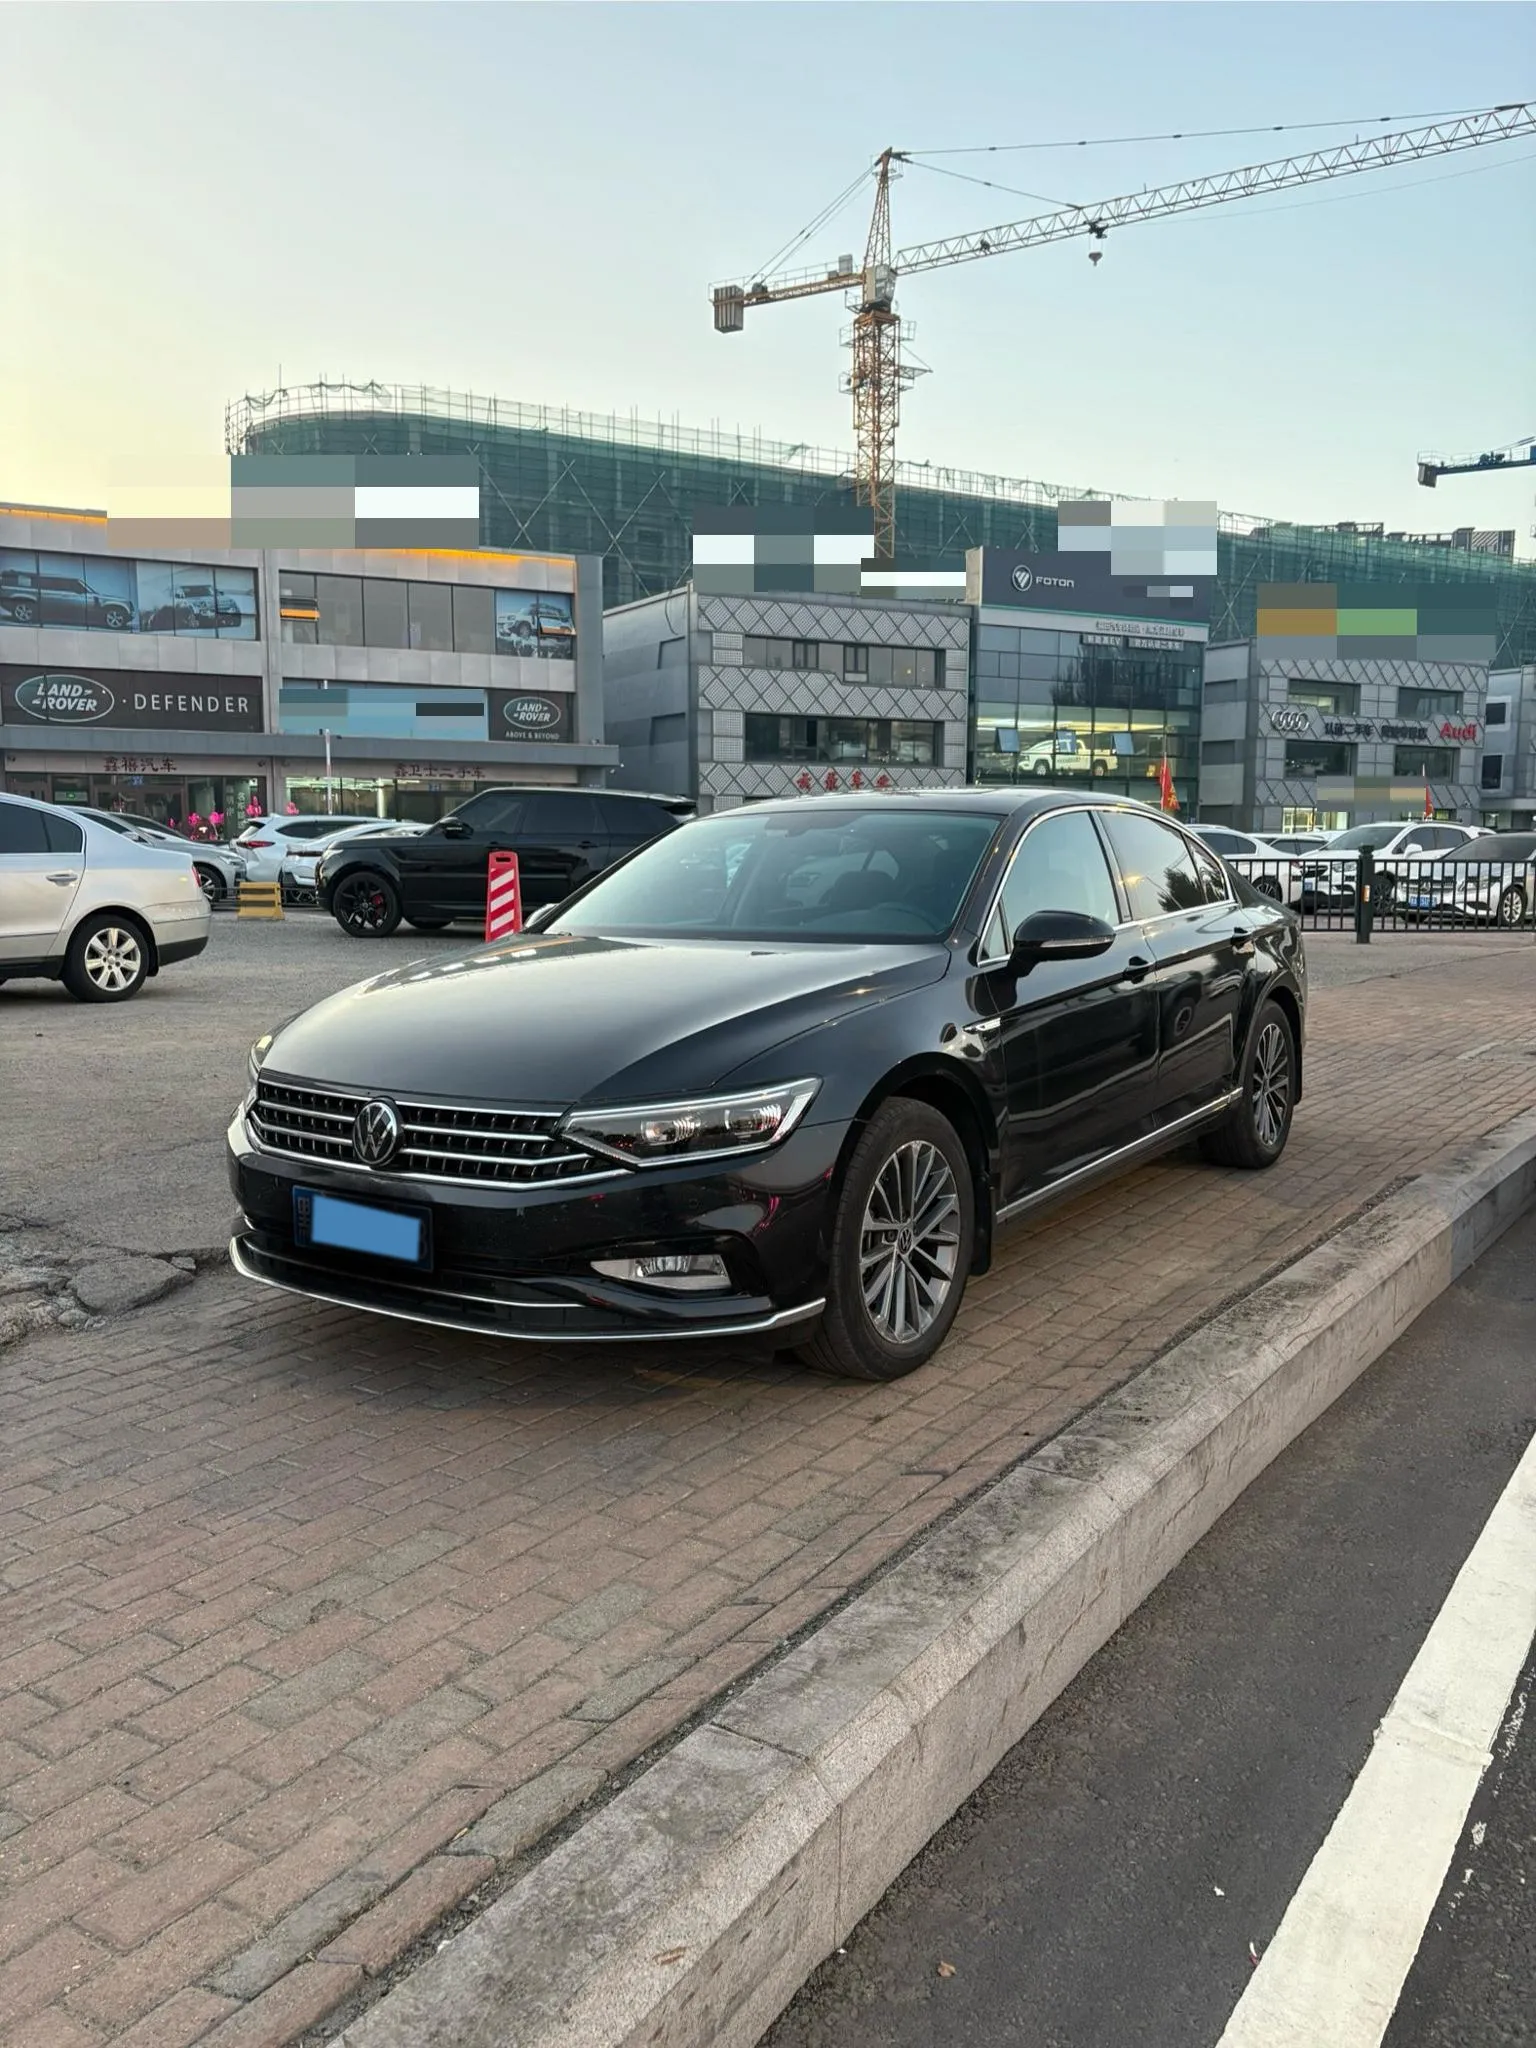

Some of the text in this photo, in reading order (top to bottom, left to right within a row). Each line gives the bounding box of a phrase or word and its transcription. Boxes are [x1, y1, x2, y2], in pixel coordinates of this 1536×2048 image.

[1036, 576, 1075, 588] FOTON
[37, 683, 83, 697] LAND
[42, 697, 97, 712] ROVER
[134, 693, 249, 714] DEFENDER
[516, 702, 542, 712] LAND
[519, 712, 551, 722] ROVER
[1440, 722, 1478, 741] Audi
